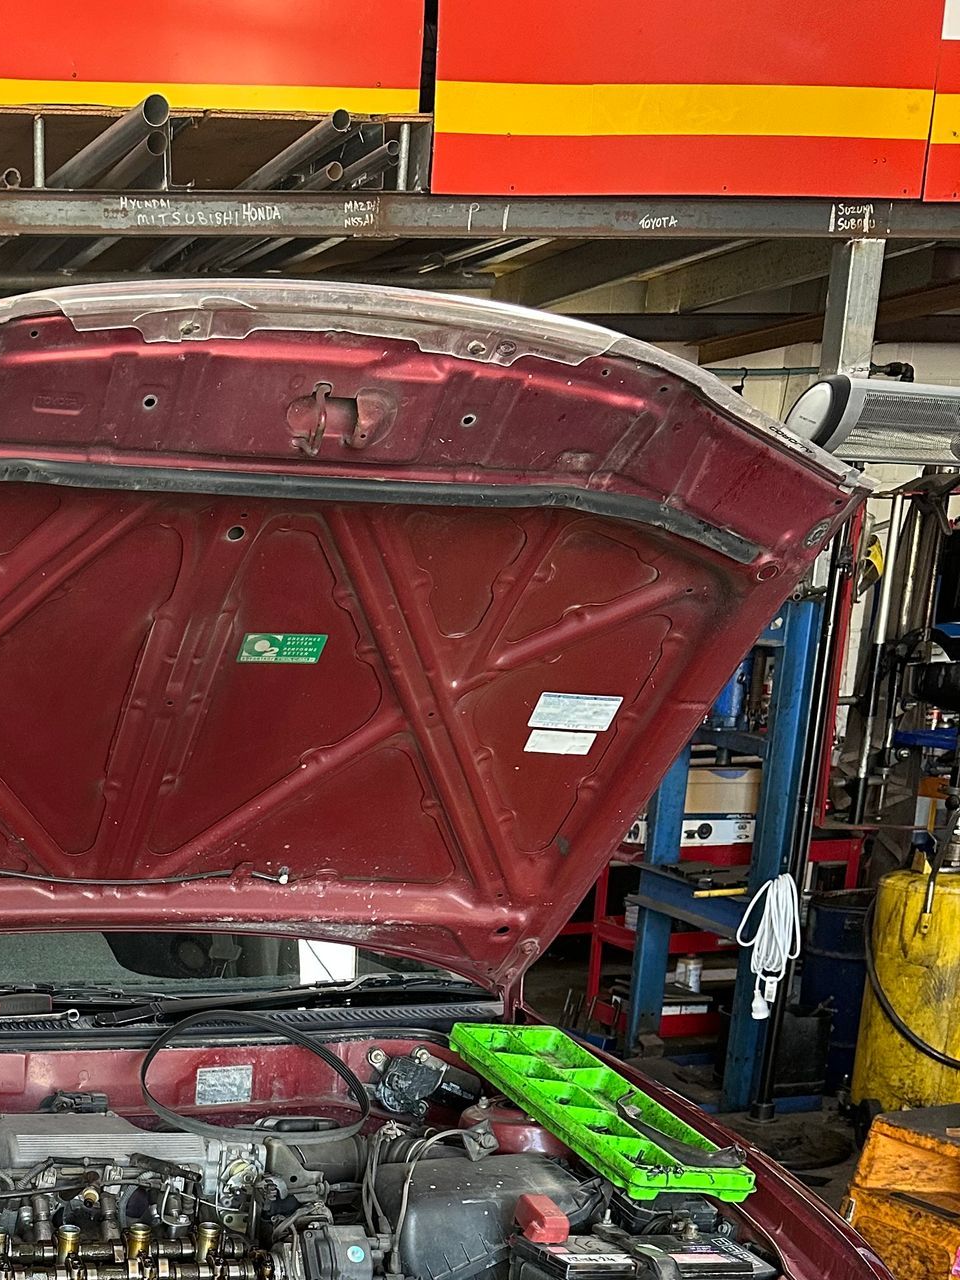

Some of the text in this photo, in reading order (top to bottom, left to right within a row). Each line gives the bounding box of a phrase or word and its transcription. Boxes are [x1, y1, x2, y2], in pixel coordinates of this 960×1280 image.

[120, 197, 172, 210] HYUNDAI
[137, 211, 239, 226] MITSUBISHI
[242, 203, 282, 222] HONDA
[639, 214, 678, 230] TOYOTA
